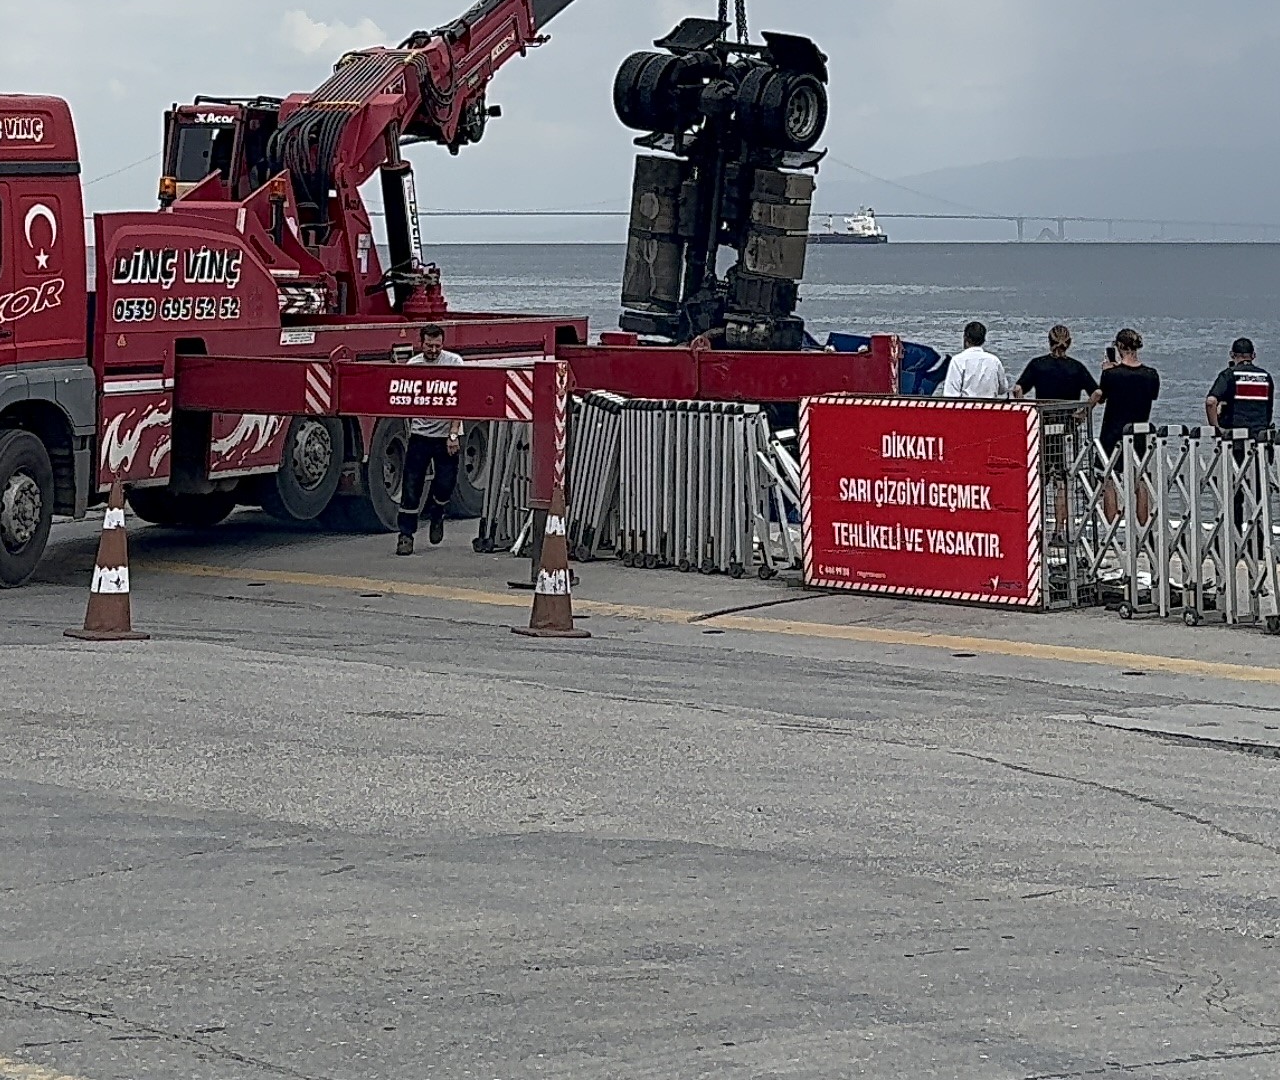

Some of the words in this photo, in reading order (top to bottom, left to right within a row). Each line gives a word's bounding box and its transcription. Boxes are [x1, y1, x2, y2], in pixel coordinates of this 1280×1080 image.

[4, 116, 45, 143] VİNÇ
[112, 245, 178, 289] DİNÇ
[183, 245, 243, 289] VİNÇ
[113, 297, 157, 322] 0539
[160, 297, 193, 320] 695
[195, 296, 216, 319] 52
[219, 296, 240, 319] 52
[389, 379, 422, 396] DİNÇ
[426, 379, 458, 396] VİNÇ
[389, 395, 412, 405] 0539
[413, 396, 431, 405] 695
[431, 396, 444, 405] 52
[445, 396, 458, 406] 52
[881, 431, 936, 460] DİKKAT
[938, 439, 945, 461] !
[839, 477, 871, 502] SARI
[874, 477, 926, 508] ÇİZGİYİ
[928, 484, 991, 512] GEÇMEK
[832, 521, 903, 551] TEHLİKELİ
[904, 528, 923, 552] VE
[926, 529, 1005, 559] YASAKTIR.
